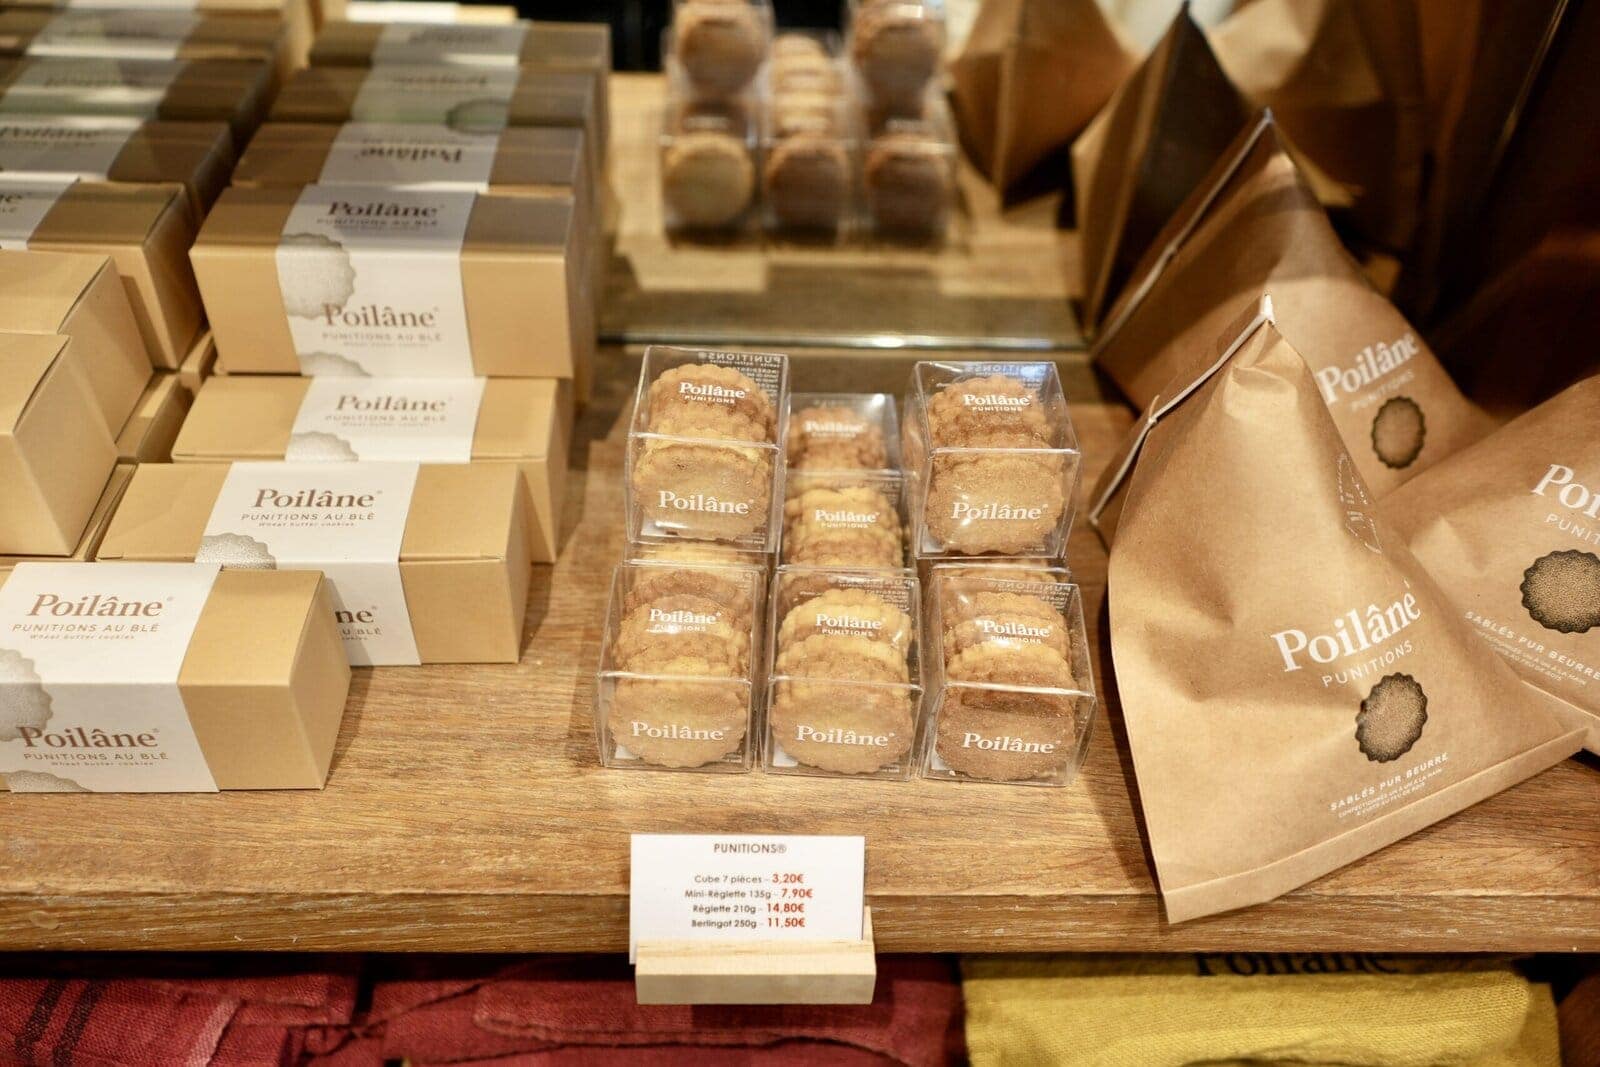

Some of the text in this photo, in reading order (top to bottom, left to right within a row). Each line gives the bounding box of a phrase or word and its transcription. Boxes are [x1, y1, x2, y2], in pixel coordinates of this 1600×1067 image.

[329, 202, 438, 217] Poilâne
[323, 303, 435, 328] Poilâne
[1316, 333, 1419, 405] Poilâne
[680, 382, 745, 398] Poilâne
[336, 395, 447, 411] Poilâne
[684, 395, 736, 404] PUNITIONS
[963, 394, 1030, 406] Poilâne
[252, 488, 375, 508] Poilâne
[658, 490, 749, 515] Poilâne
[240, 512, 376, 521] PUNITIONS AU BLÉ
[815, 508, 878, 523] Poilâne
[950, 501, 1042, 520] Poilâne
[26, 593, 164, 617] Poilâne
[650, 608, 717, 624] Poilâne
[815, 613, 882, 629] Poilâne
[12, 622, 161, 633] PUNITIONS AU BLÉ
[983, 620, 1050, 637] Poilâne
[1270, 592, 1421, 672] Poilâne
[1464, 611, 1600, 680] SABLÉS PUR BEURRE
[1322, 640, 1413, 688] PUNITIONS
[16, 726, 159, 748] Poilâne
[631, 721, 725, 741] Poilâne
[796, 725, 889, 747] Poilâne
[962, 732, 1055, 754] Poilâne
[24, 752, 108, 761] PUNITIONS
[141, 751, 169, 760] BLÉ
[1329, 752, 1449, 811] SABLÉS PUR BEURRE
[713, 843, 787, 854] PUNITIONS®
[694, 874, 720, 884] Cube
[722, 874, 728, 883] 7
[731, 874, 762, 885] pièces
[772, 873, 805, 885] 3,20€
[749, 889, 772, 900] 135g
[781, 888, 813, 899] 7,90€
[734, 904, 757, 914] 210g
[766, 903, 806, 914] 14,80€
[691, 919, 732, 929] Berlingot
[734, 919, 757, 929] 250g
[767, 917, 806, 929] 11,50€
